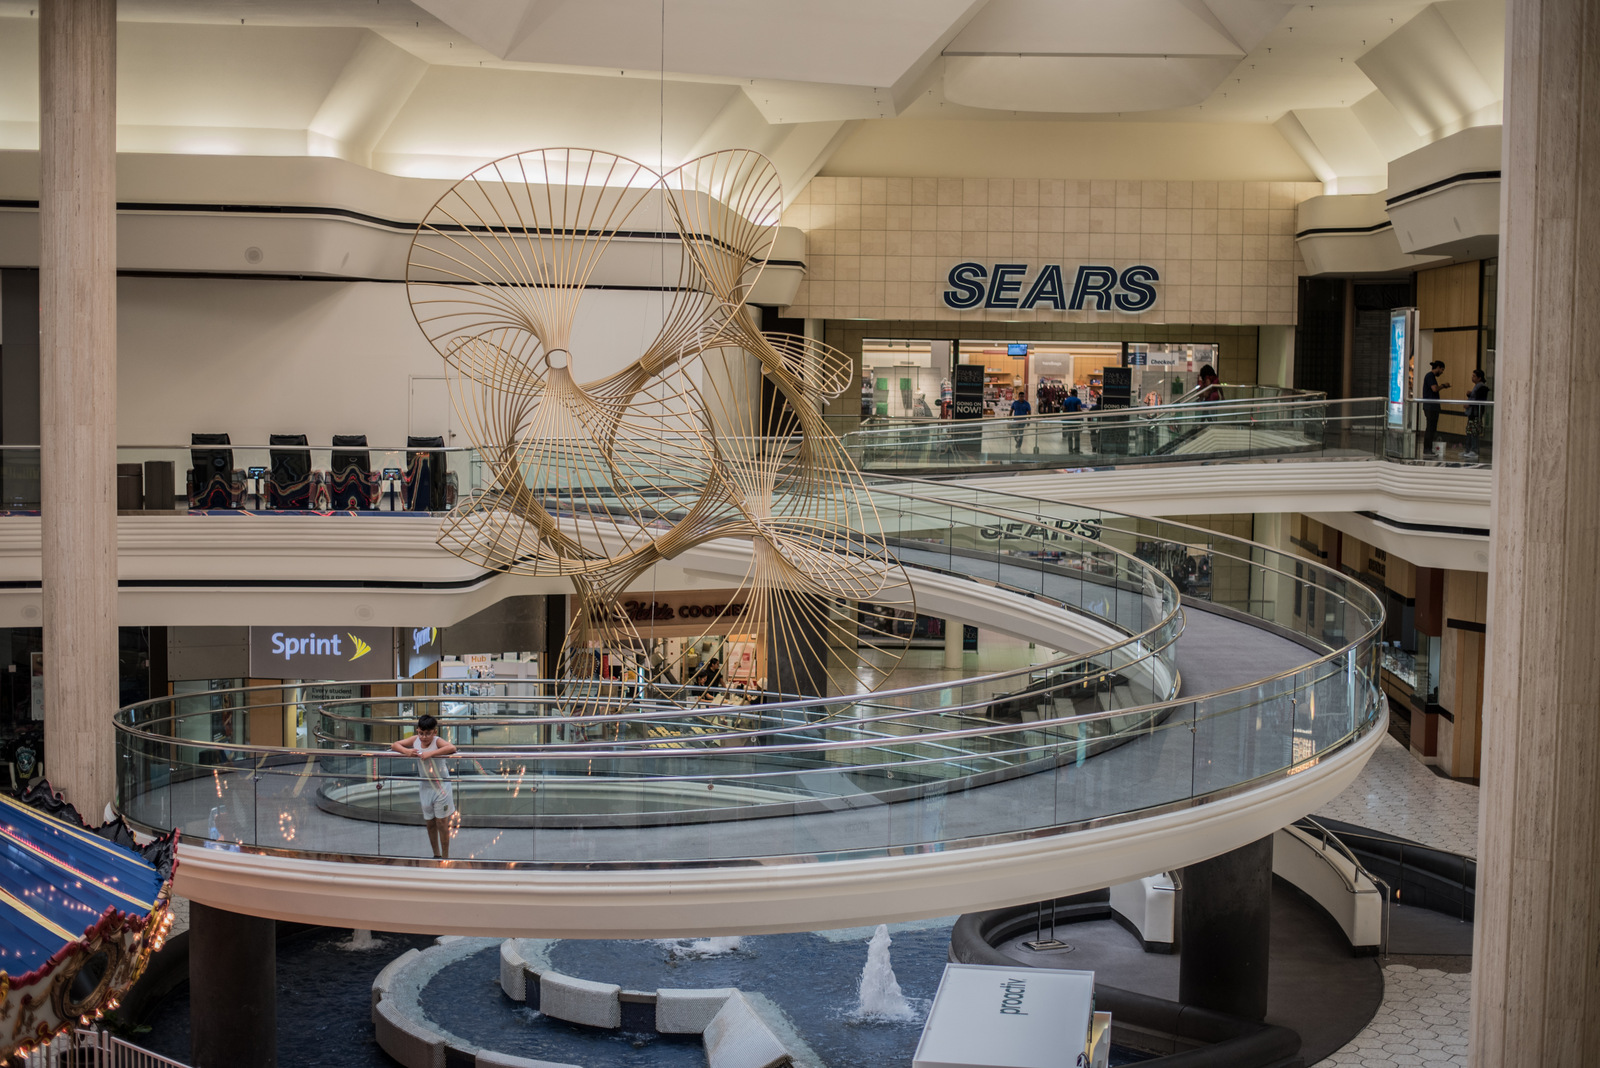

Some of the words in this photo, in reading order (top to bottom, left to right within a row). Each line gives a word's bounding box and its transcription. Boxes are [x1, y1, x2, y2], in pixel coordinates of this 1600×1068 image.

[943, 262, 1160, 312] SEARS
[956, 406, 982, 414] NOW!
[980, 519, 1103, 541] SEARS
[271, 632, 341, 660] Sprint
[471, 655, 487, 663] Hub
[1000, 978, 1028, 1015] proactiv
